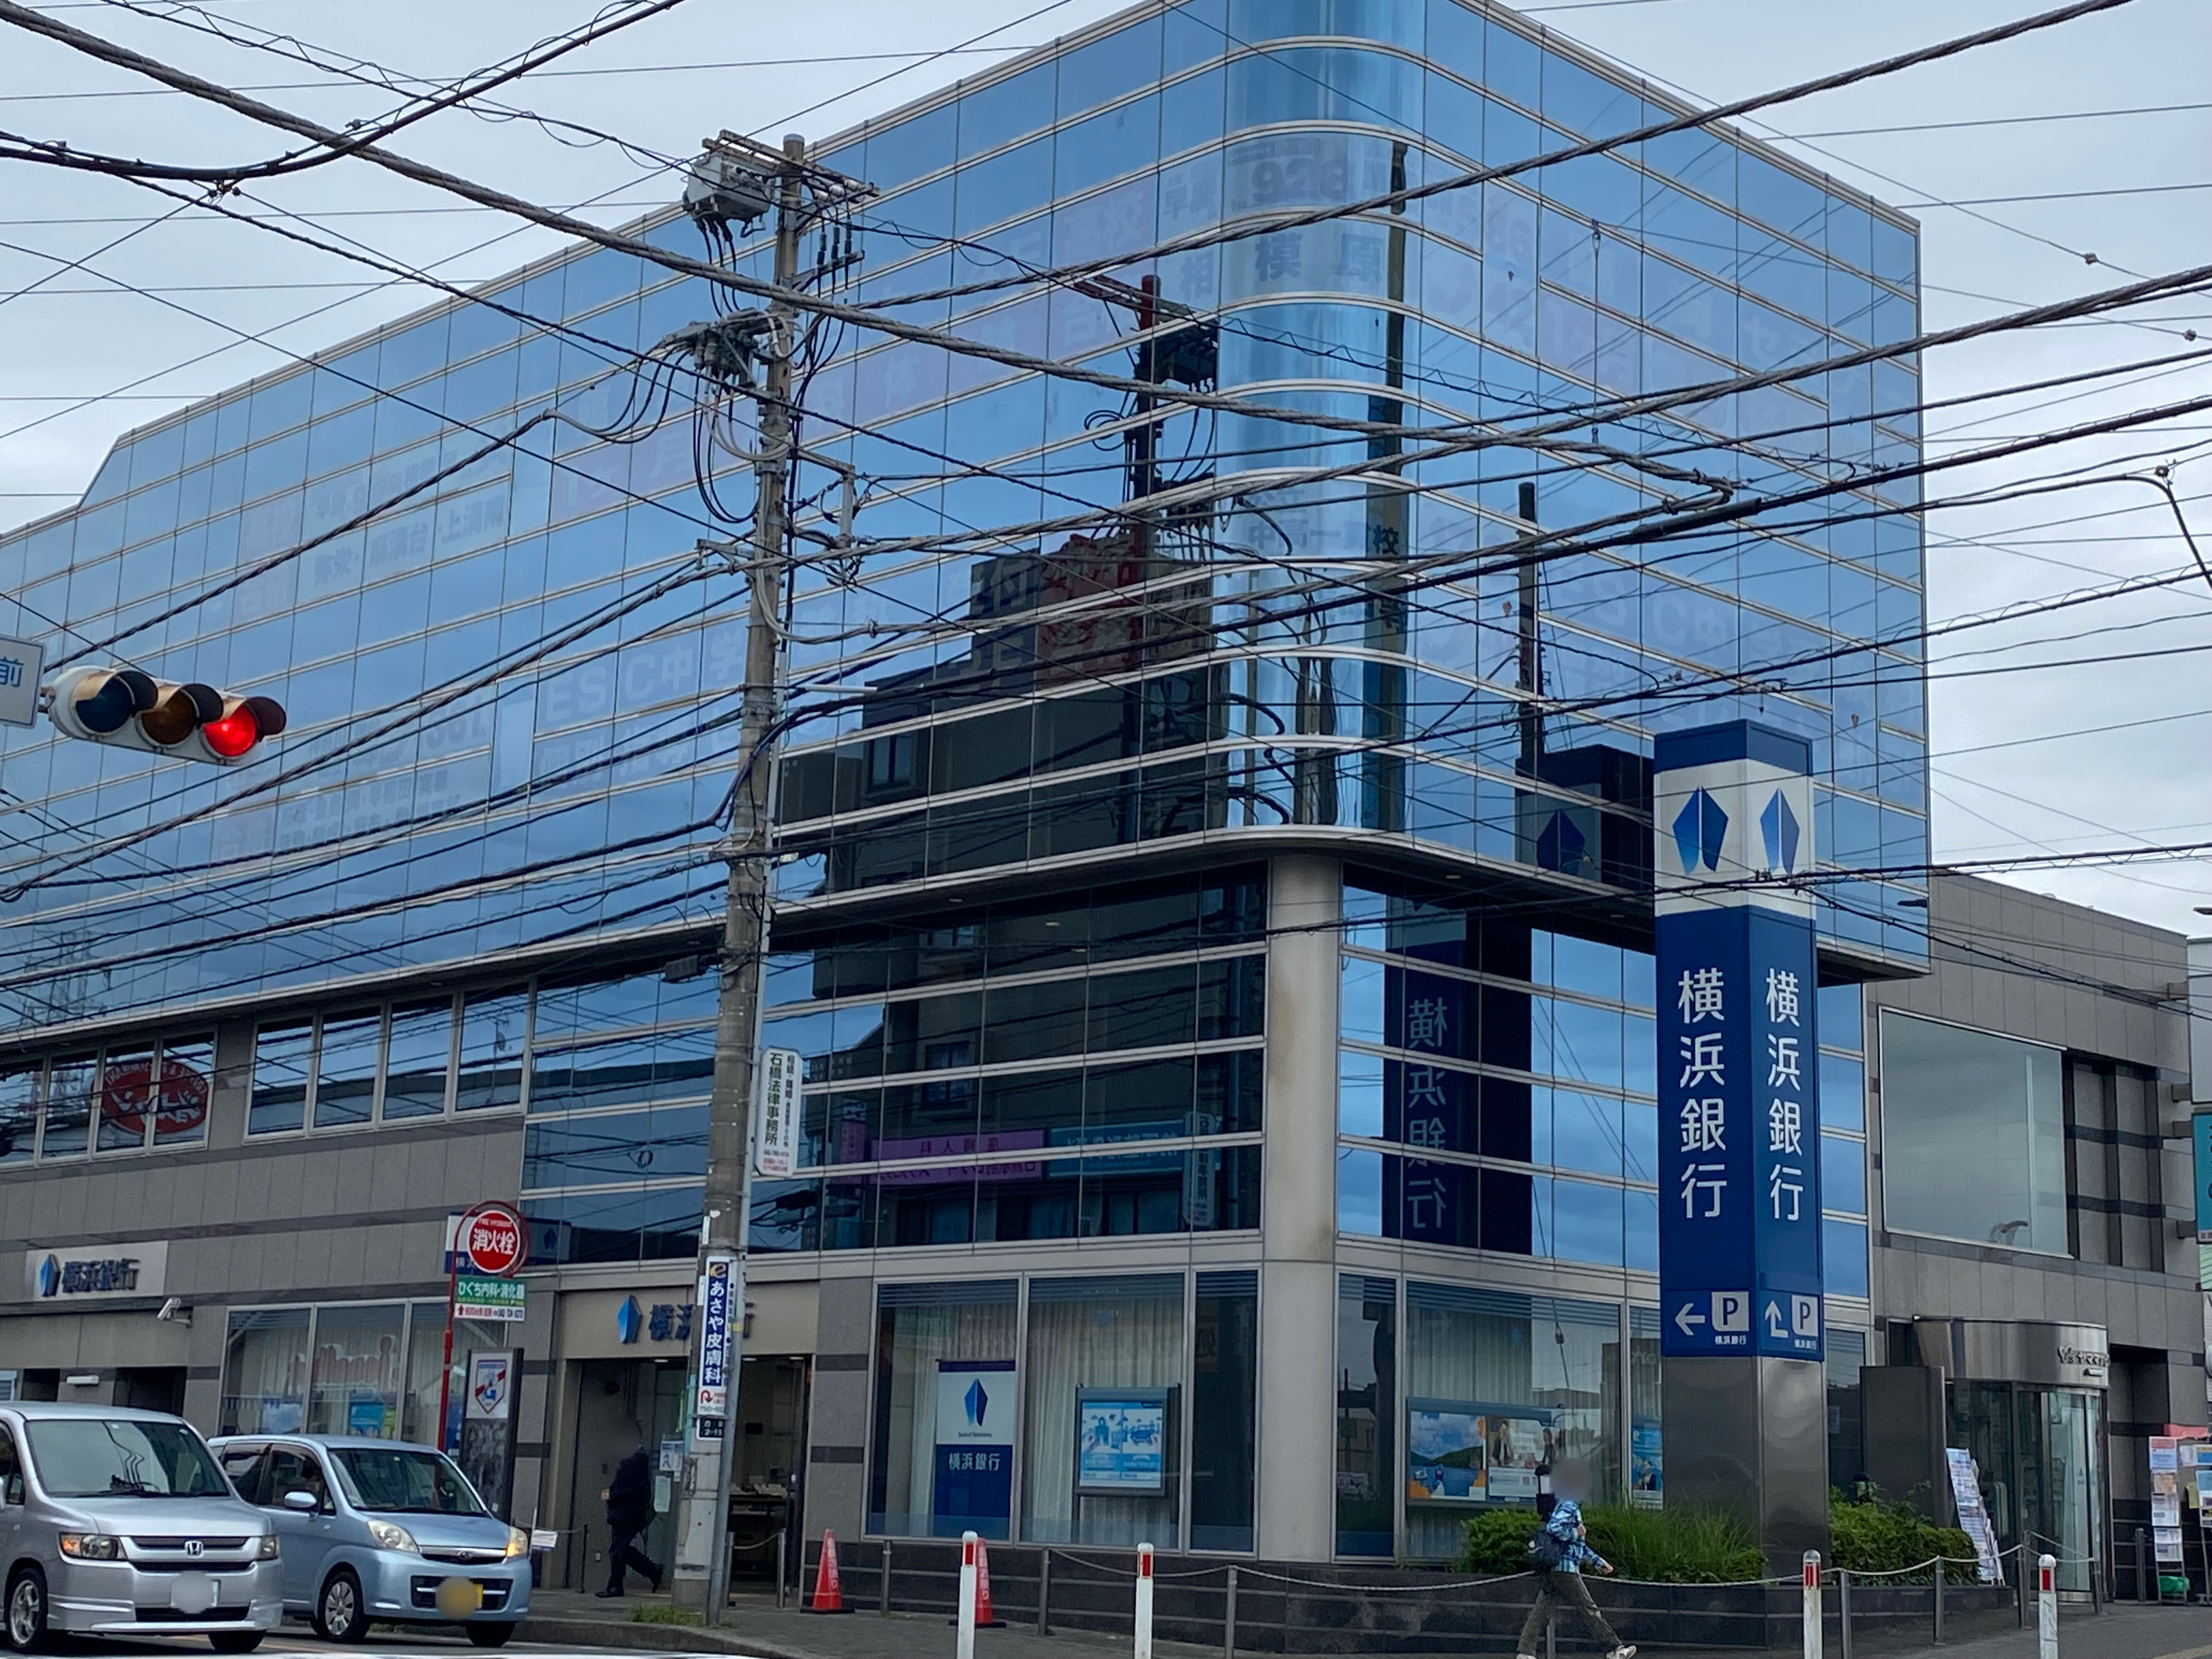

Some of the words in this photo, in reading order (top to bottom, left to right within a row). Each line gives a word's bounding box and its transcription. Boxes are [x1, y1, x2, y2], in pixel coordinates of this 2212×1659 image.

[0, 656, 25, 687] 前
[764, 1052, 783, 1146] 石橋法律事務所
[1678, 967, 1728, 1219] 横浜銀行
[1765, 967, 1804, 1221] 横浜銀行
[472, 1228, 516, 1255] 消火栓
[1722, 1297, 1739, 1326] P
[1799, 1301, 1811, 1330] P
[705, 1280, 725, 1384] あさや皮膚科
[949, 1452, 1000, 1471] 横浜銀行
